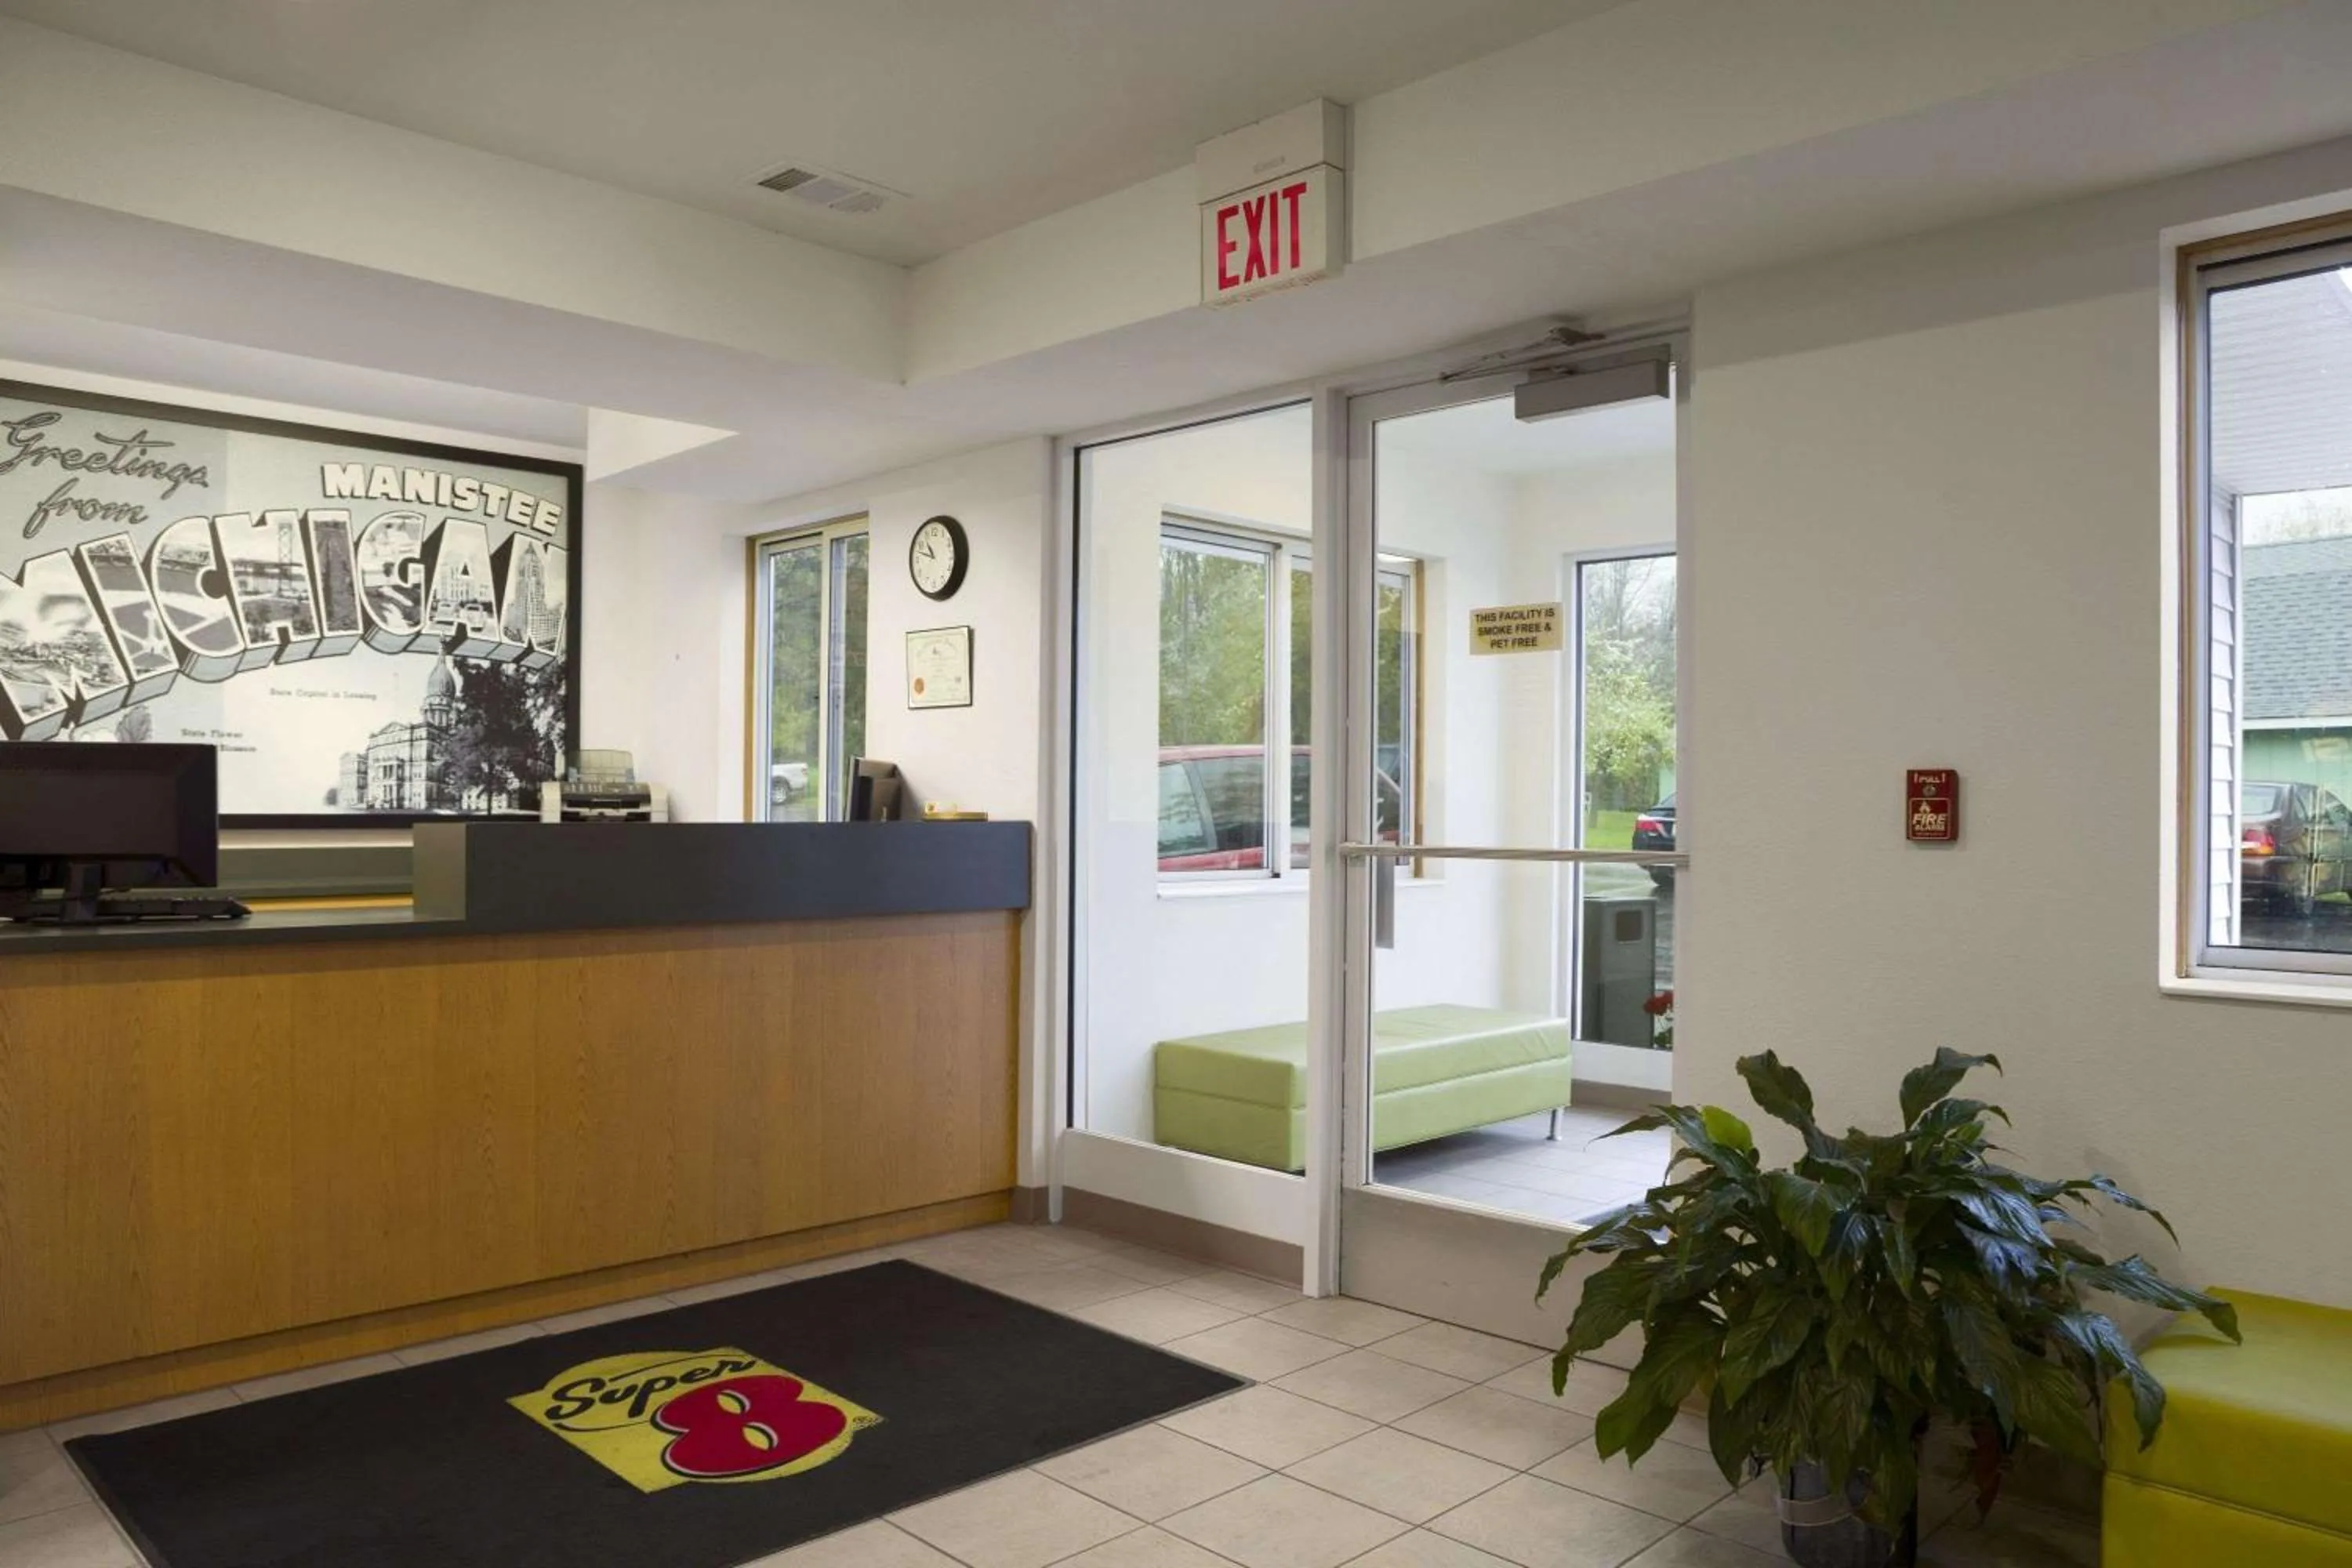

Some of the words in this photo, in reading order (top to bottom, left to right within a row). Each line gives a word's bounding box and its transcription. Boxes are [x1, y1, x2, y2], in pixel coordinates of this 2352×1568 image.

[1217, 181, 1307, 291] EXIT
[0, 411, 209, 500] Greetings
[22, 477, 149, 539] from
[321, 461, 562, 536] MANISTEE
[0, 508, 569, 729] MICHIGAN
[1475, 613, 1497, 622] THIS
[1498, 609, 1541, 622] FACILITY
[1544, 608, 1555, 618] IS
[1477, 625, 1513, 637] SMOKE
[1515, 622, 1542, 634] FREE
[1490, 638, 1508, 649] PET
[1511, 636, 1538, 648] FREE
[1913, 813, 1946, 825] FIRE
[544, 1359, 756, 1420] Super
